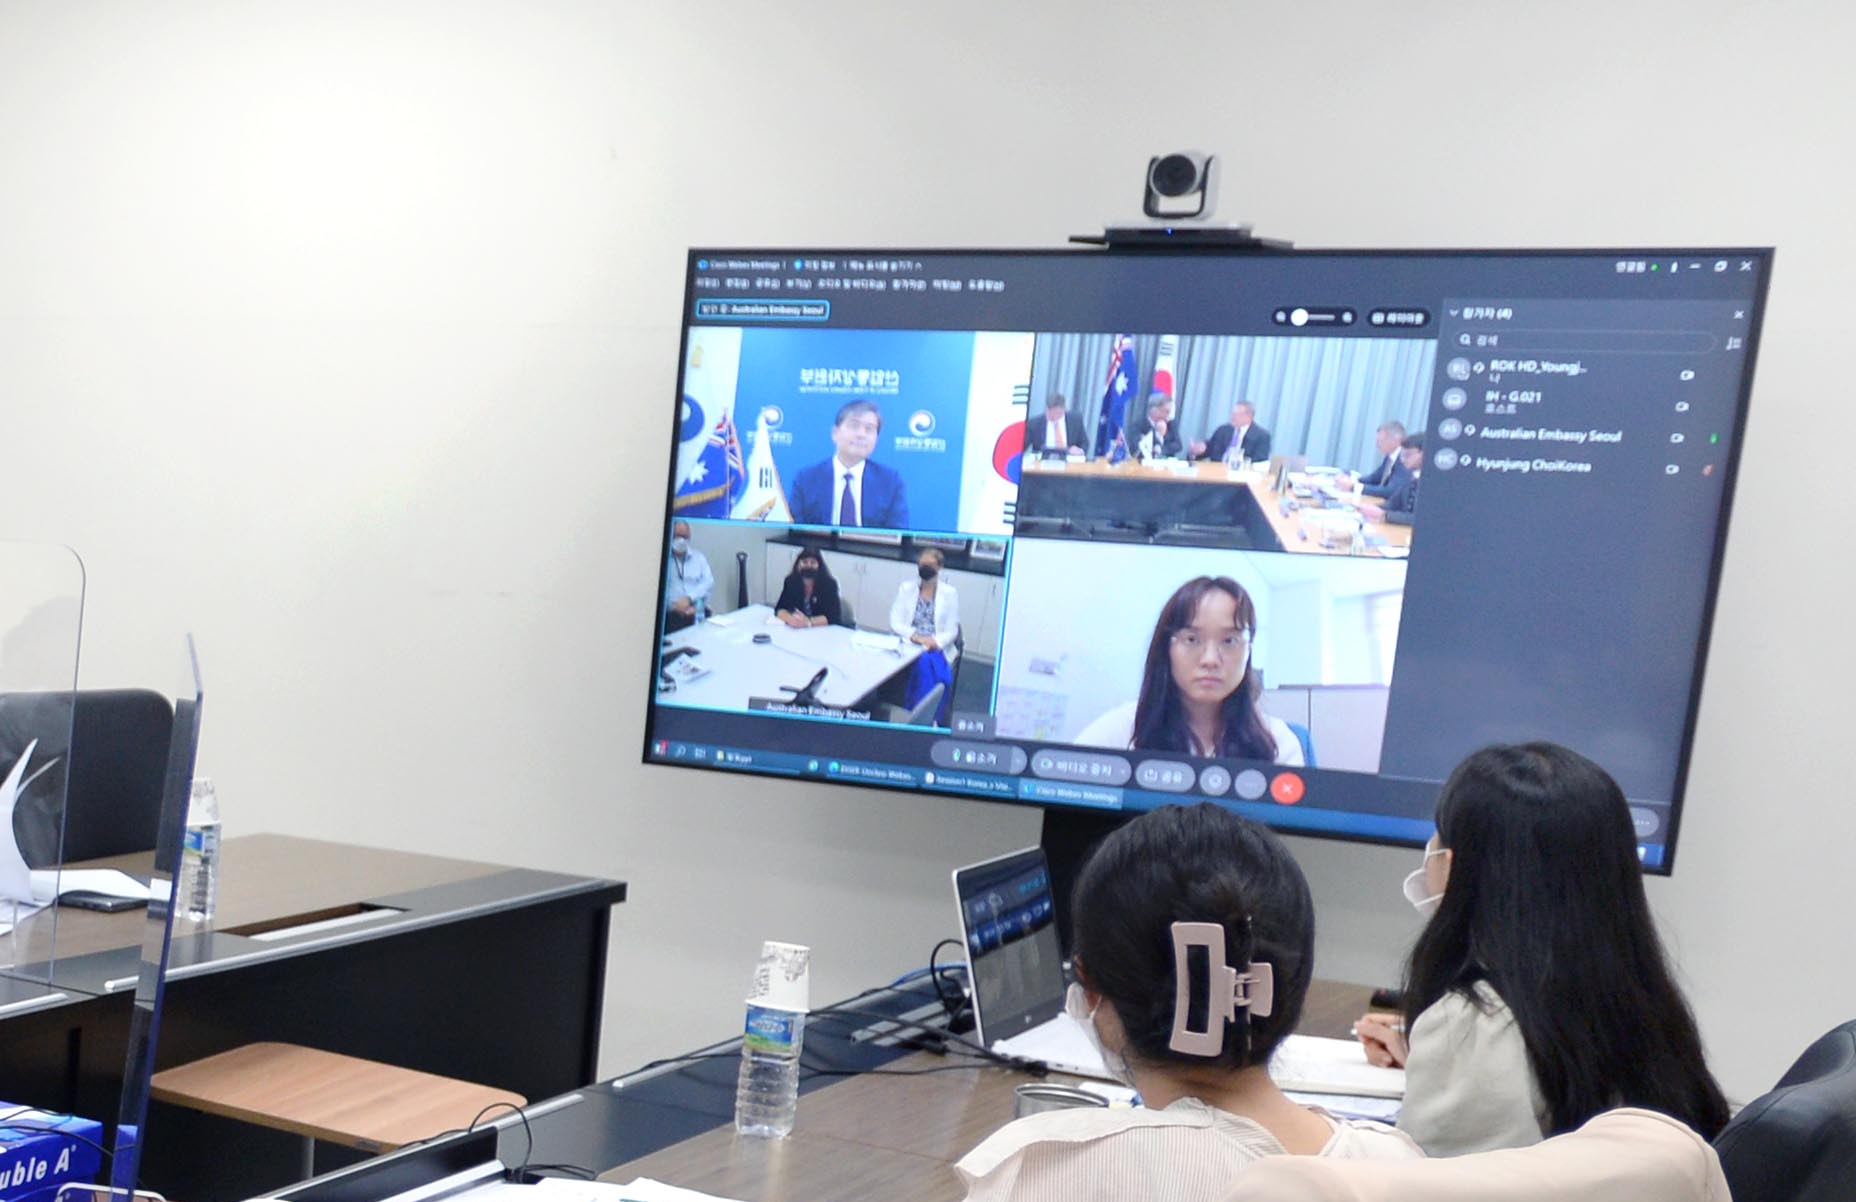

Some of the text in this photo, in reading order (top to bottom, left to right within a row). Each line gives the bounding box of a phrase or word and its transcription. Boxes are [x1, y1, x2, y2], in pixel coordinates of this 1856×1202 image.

[1480, 426, 1623, 444] Australian Embassy Seoul
